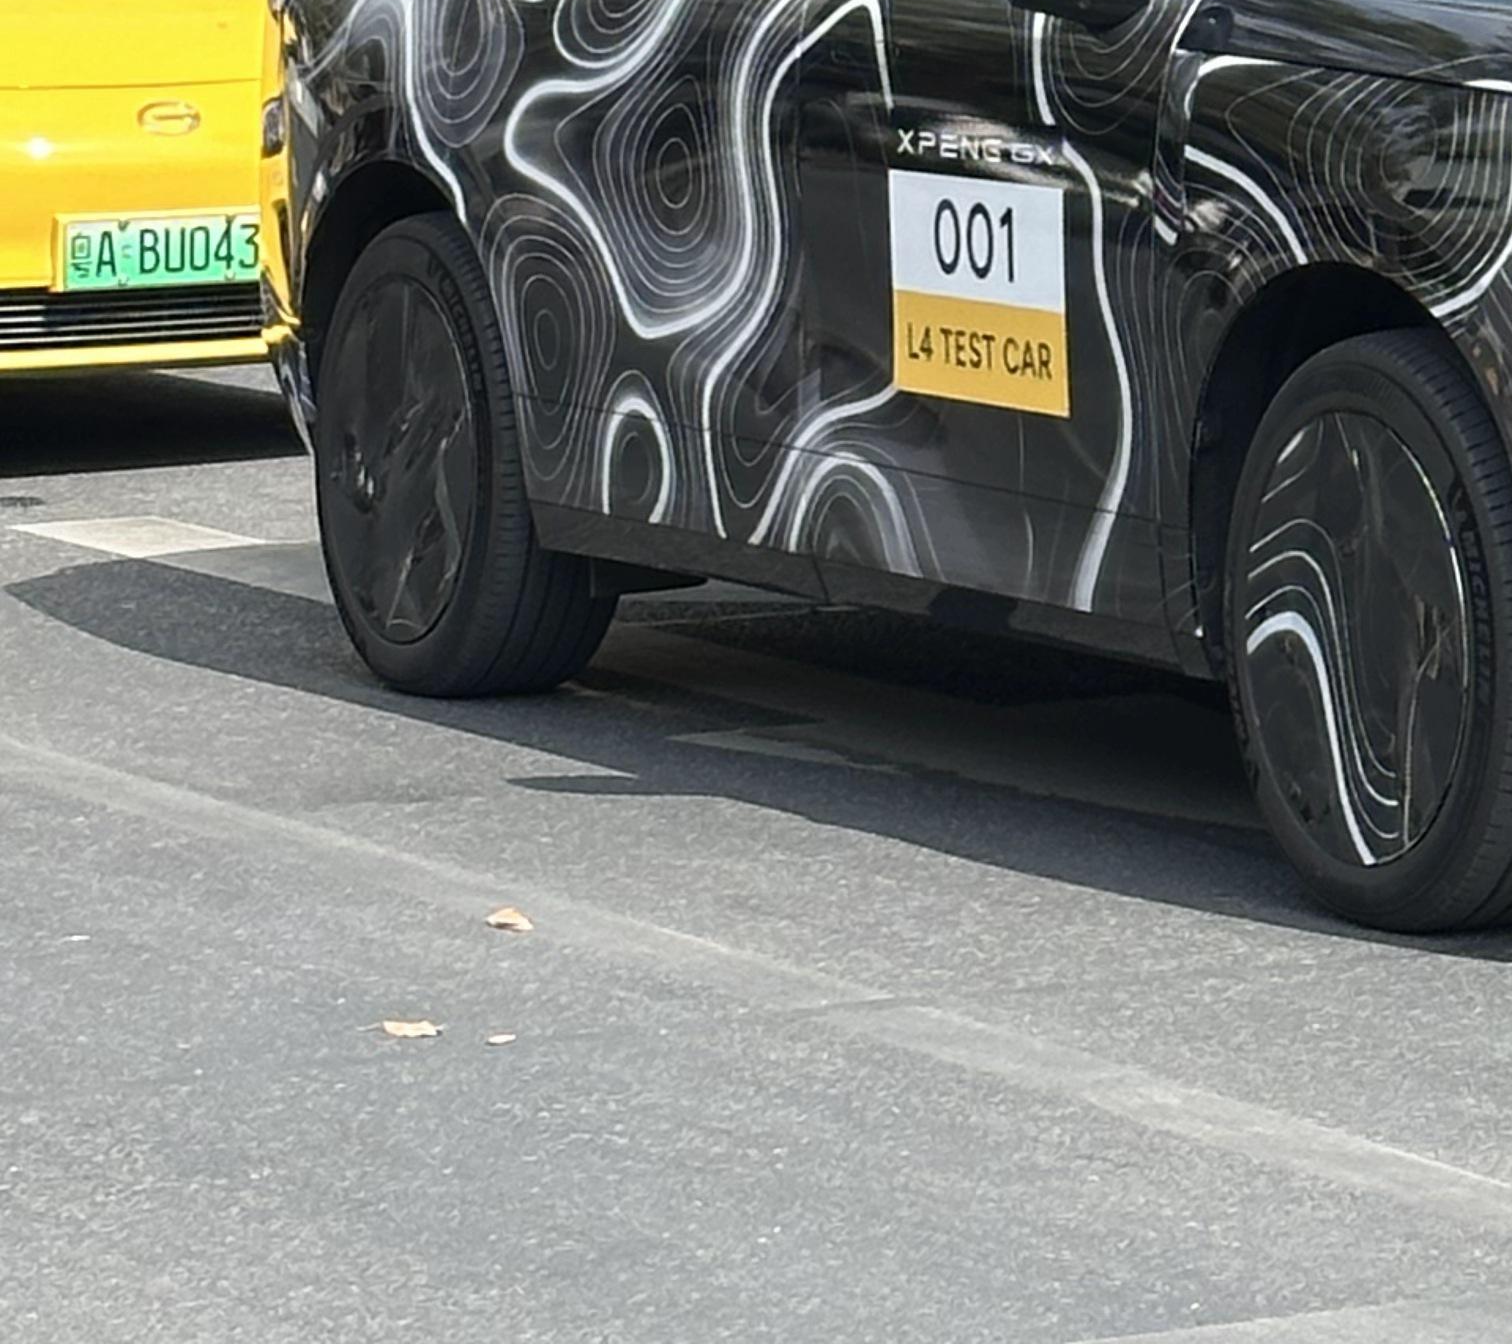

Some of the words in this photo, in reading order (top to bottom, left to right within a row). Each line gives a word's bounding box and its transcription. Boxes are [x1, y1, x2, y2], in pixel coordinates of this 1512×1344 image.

[897, 127, 1003, 163] XPENG
[1009, 142, 1054, 166] GX
[934, 198, 1015, 283] 001
[906, 322, 934, 360] L4
[939, 327, 996, 370] TEST
[1002, 337, 1053, 380] CAR
